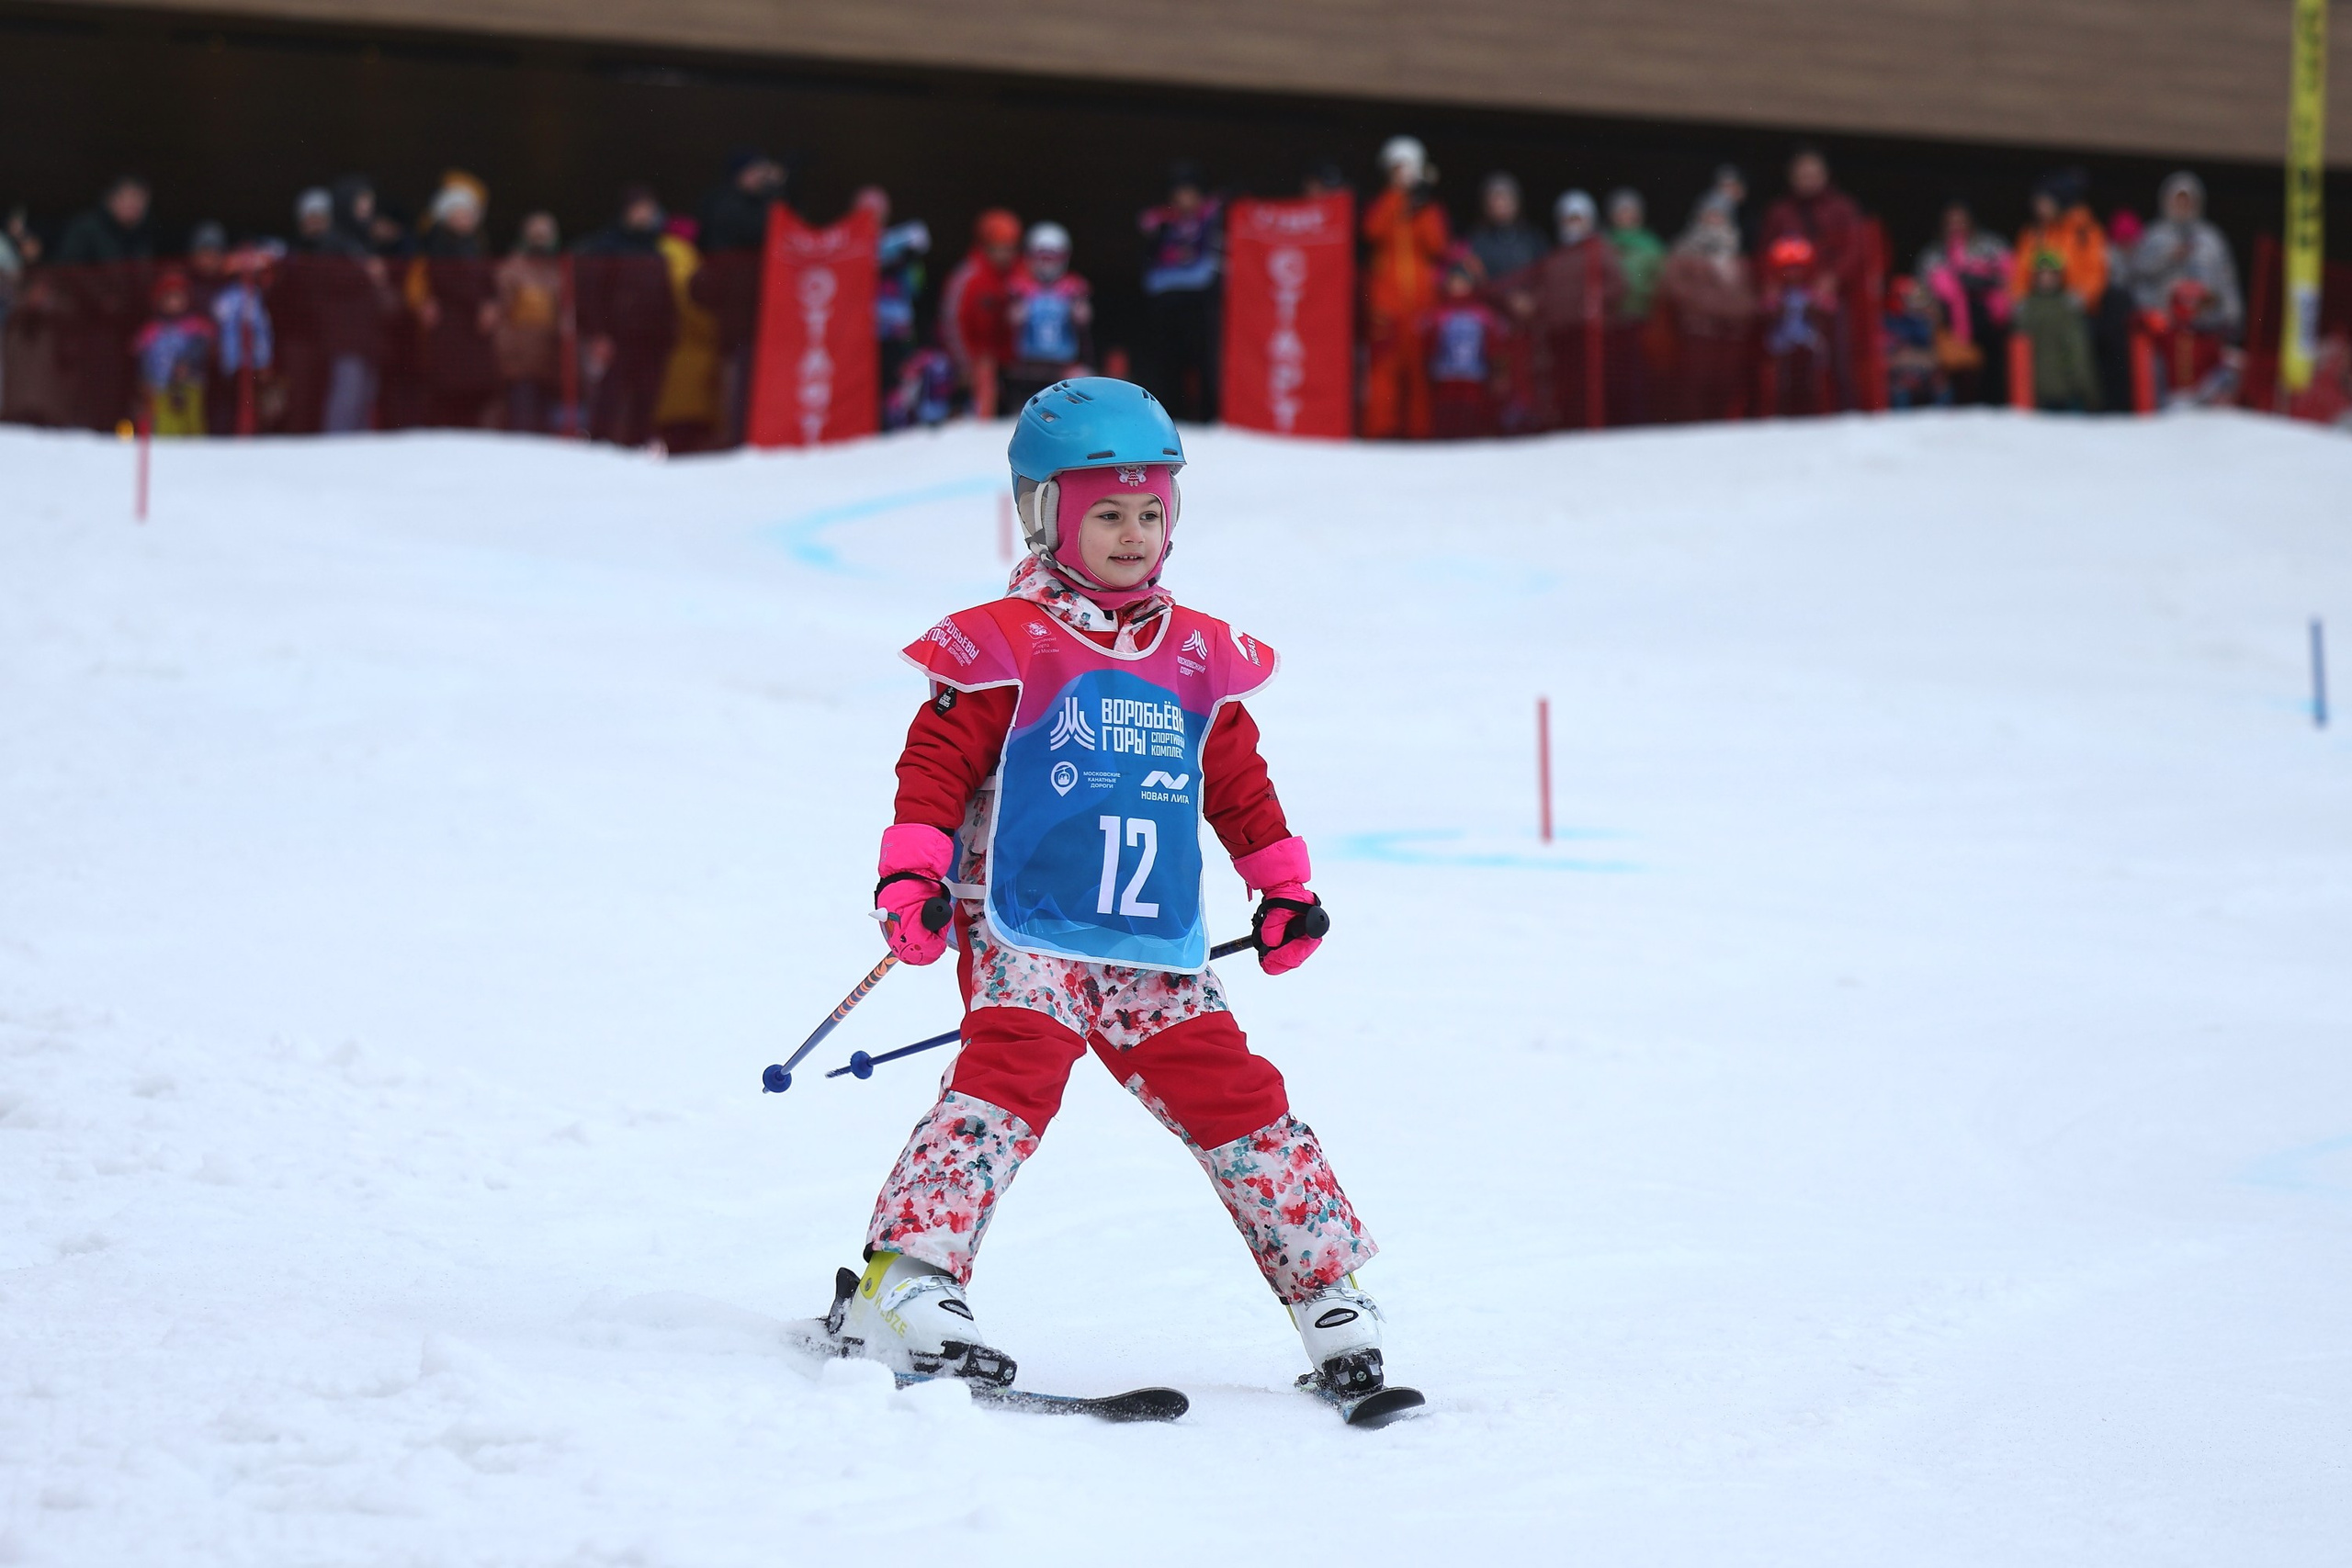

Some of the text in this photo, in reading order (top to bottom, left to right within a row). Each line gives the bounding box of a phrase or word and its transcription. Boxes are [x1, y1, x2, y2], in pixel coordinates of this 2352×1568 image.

[935, 616, 979, 660] ОРОБЬЁВЫ
[1247, 637, 1261, 668] НОВАЯ
[1102, 726, 1147, 756] ГОРЫ
[1082, 771, 1122, 779] МОСКОВСКИЕ
[1140, 790, 1190, 805] НОВАЯ ЛИГА
[1096, 815, 1159, 919] 12
